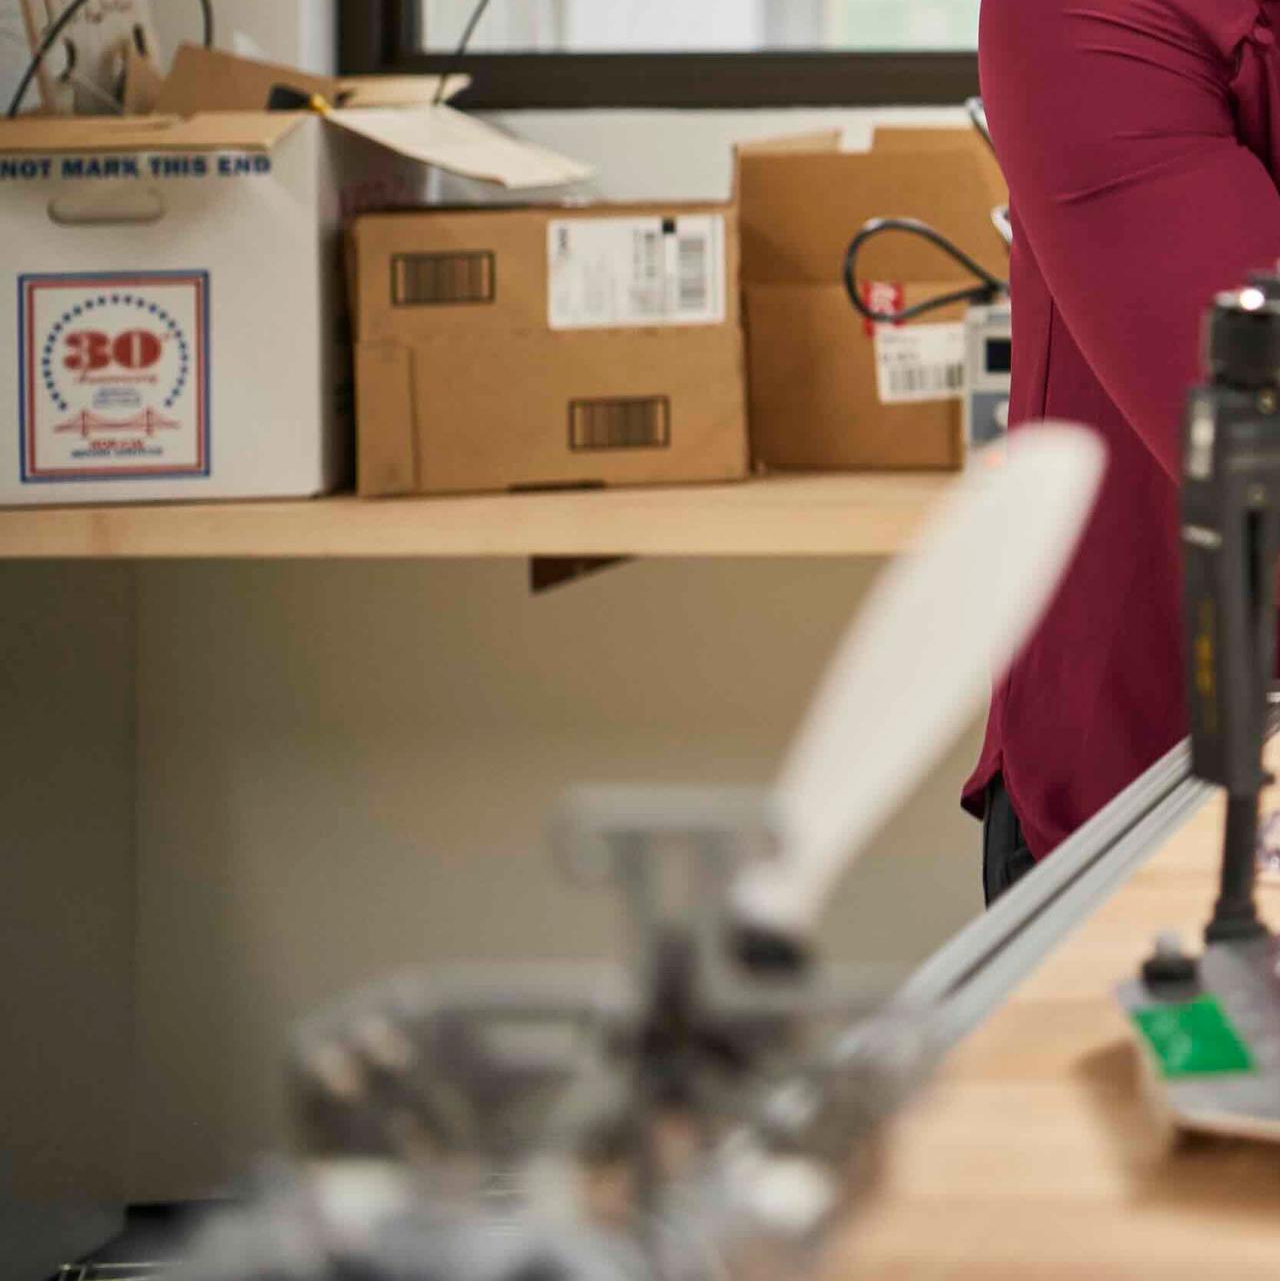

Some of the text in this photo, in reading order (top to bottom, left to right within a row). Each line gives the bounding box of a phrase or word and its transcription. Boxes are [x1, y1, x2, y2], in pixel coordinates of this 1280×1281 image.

[0, 153, 271, 180] NOT MARK THIS END
